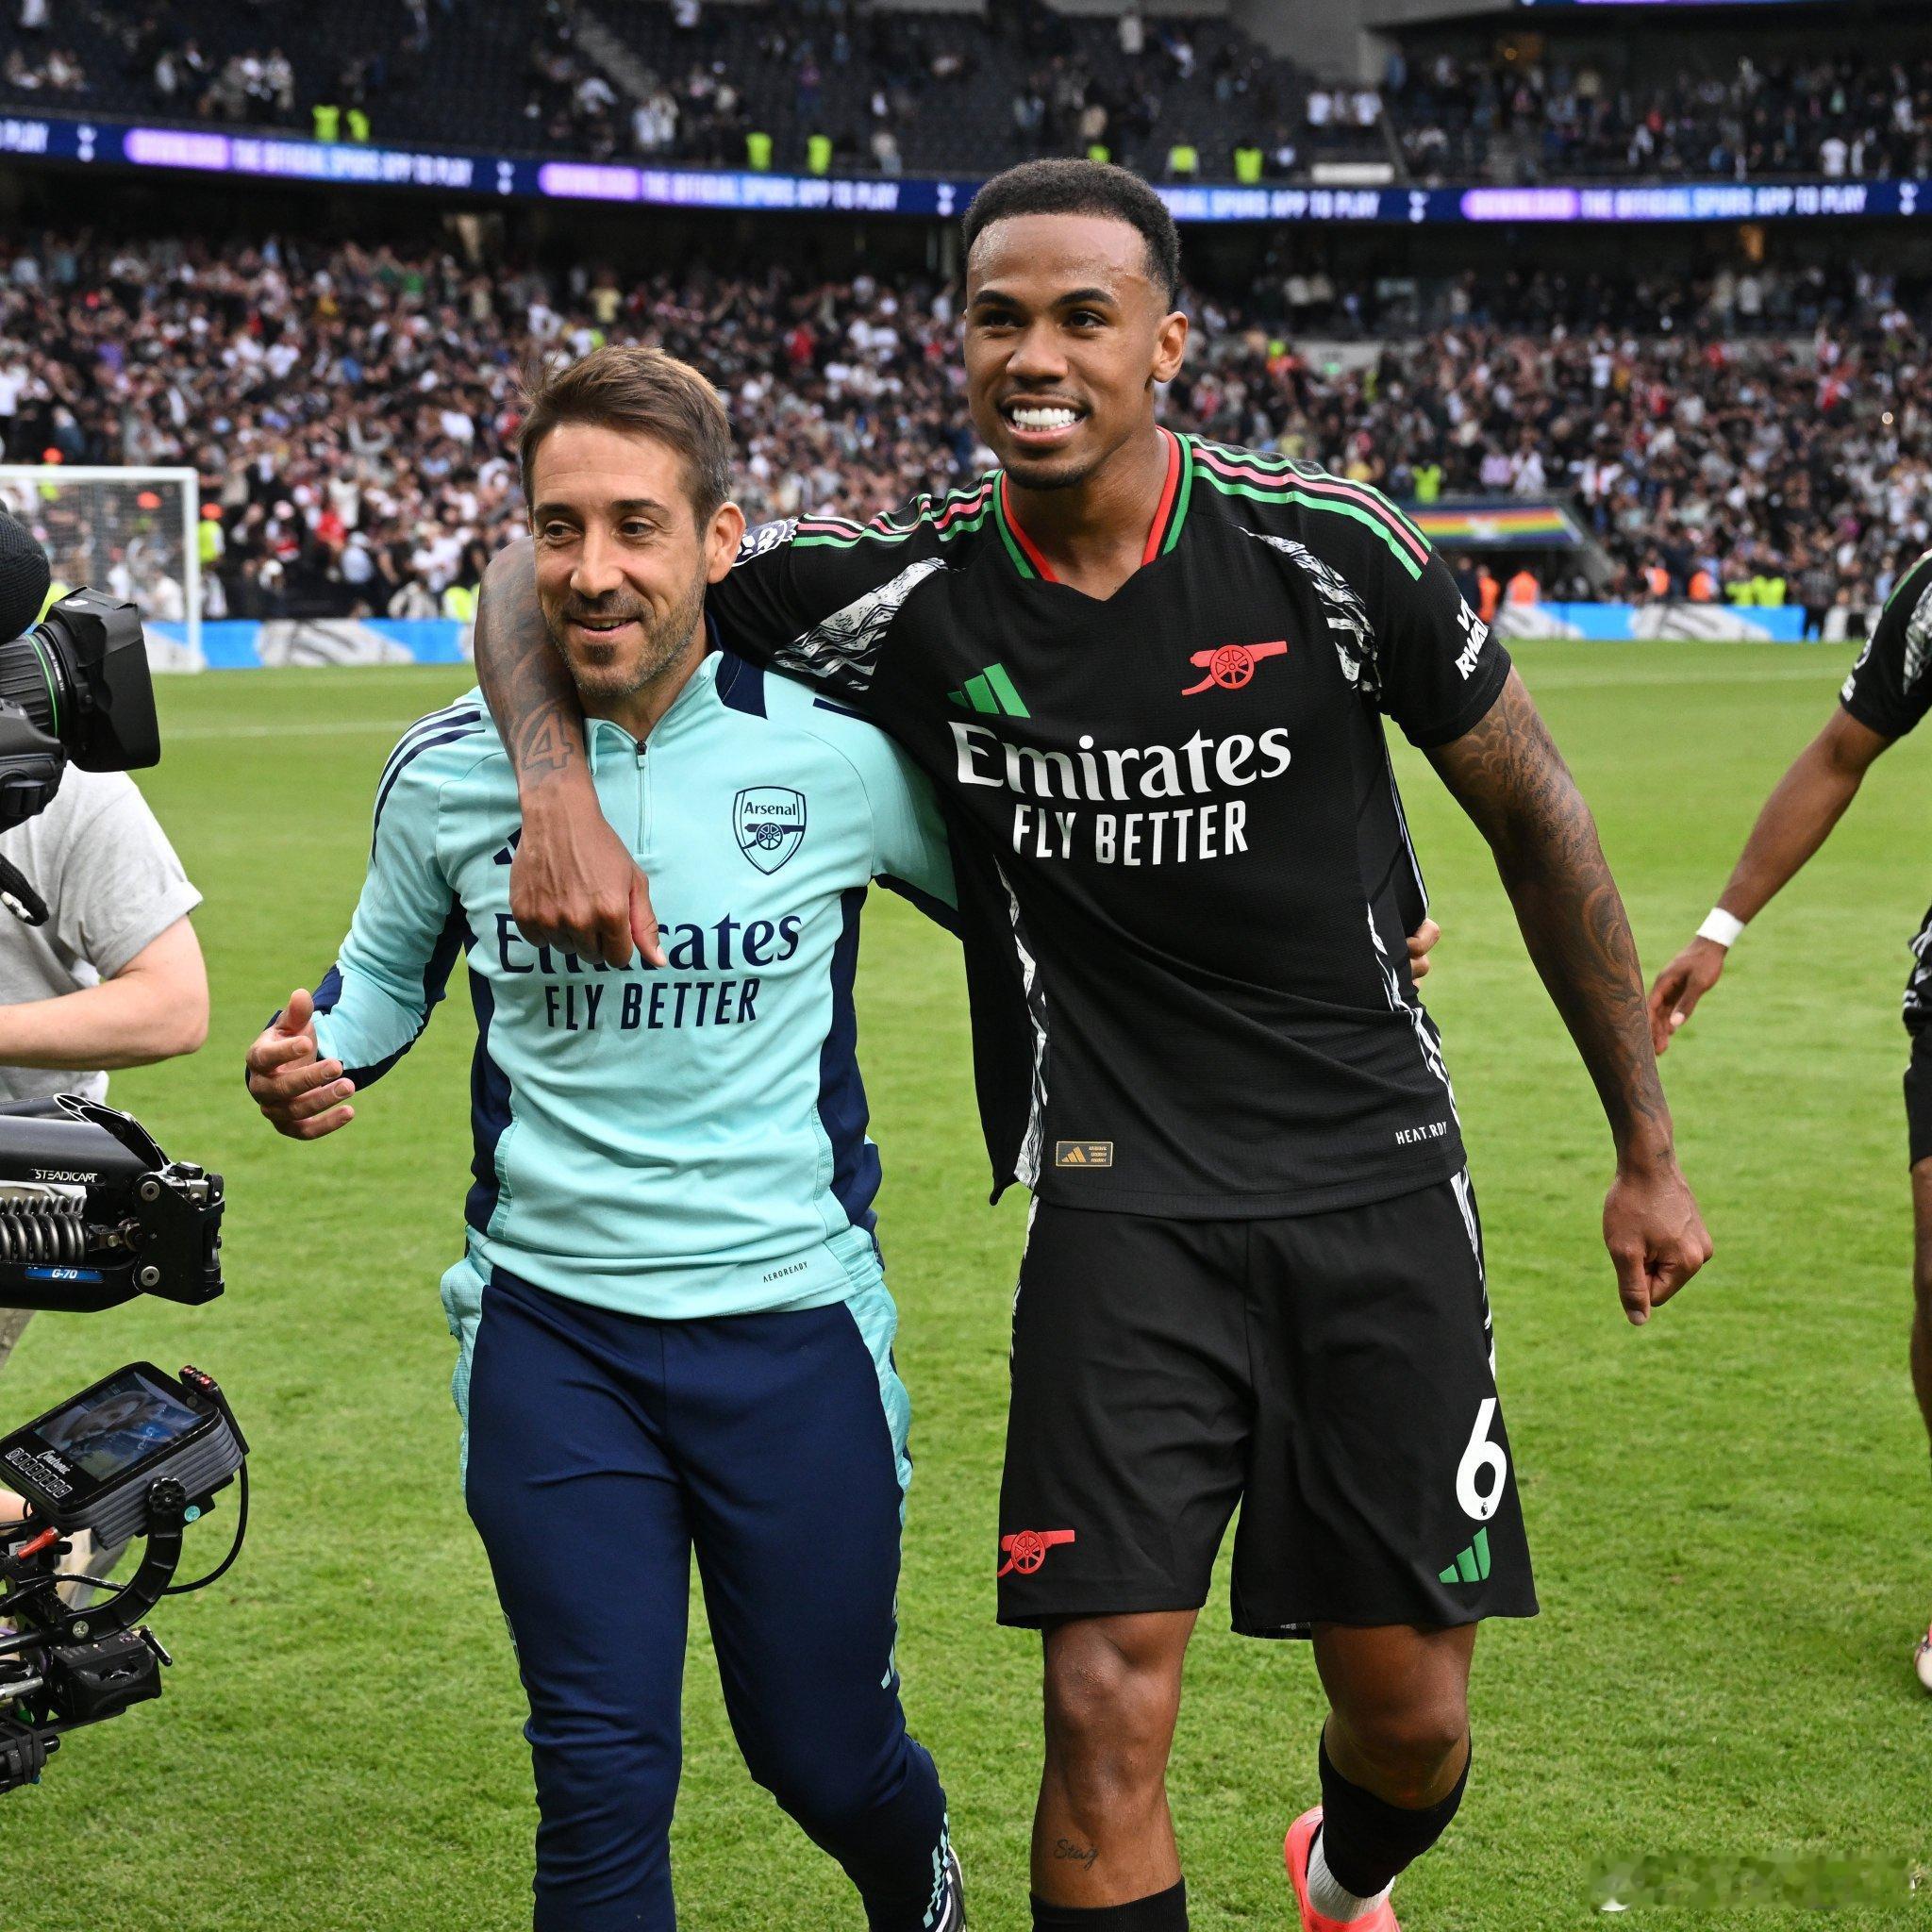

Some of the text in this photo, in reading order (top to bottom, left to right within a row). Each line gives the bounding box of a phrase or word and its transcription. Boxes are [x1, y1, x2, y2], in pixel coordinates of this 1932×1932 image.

[948, 721, 1291, 801] Emirates
[743, 801, 796, 817] Arsenal
[1012, 800, 1249, 866] FLY BETTER
[494, 912, 802, 974] Eates
[544, 978, 760, 1030] FLY BETTER
[1395, 1121, 1447, 1145] HEAT.RDY
[52, 1269, 78, 1279] G-70
[763, 1261, 808, 1283] AEROREADY
[1456, 1397, 1507, 1521] 6
